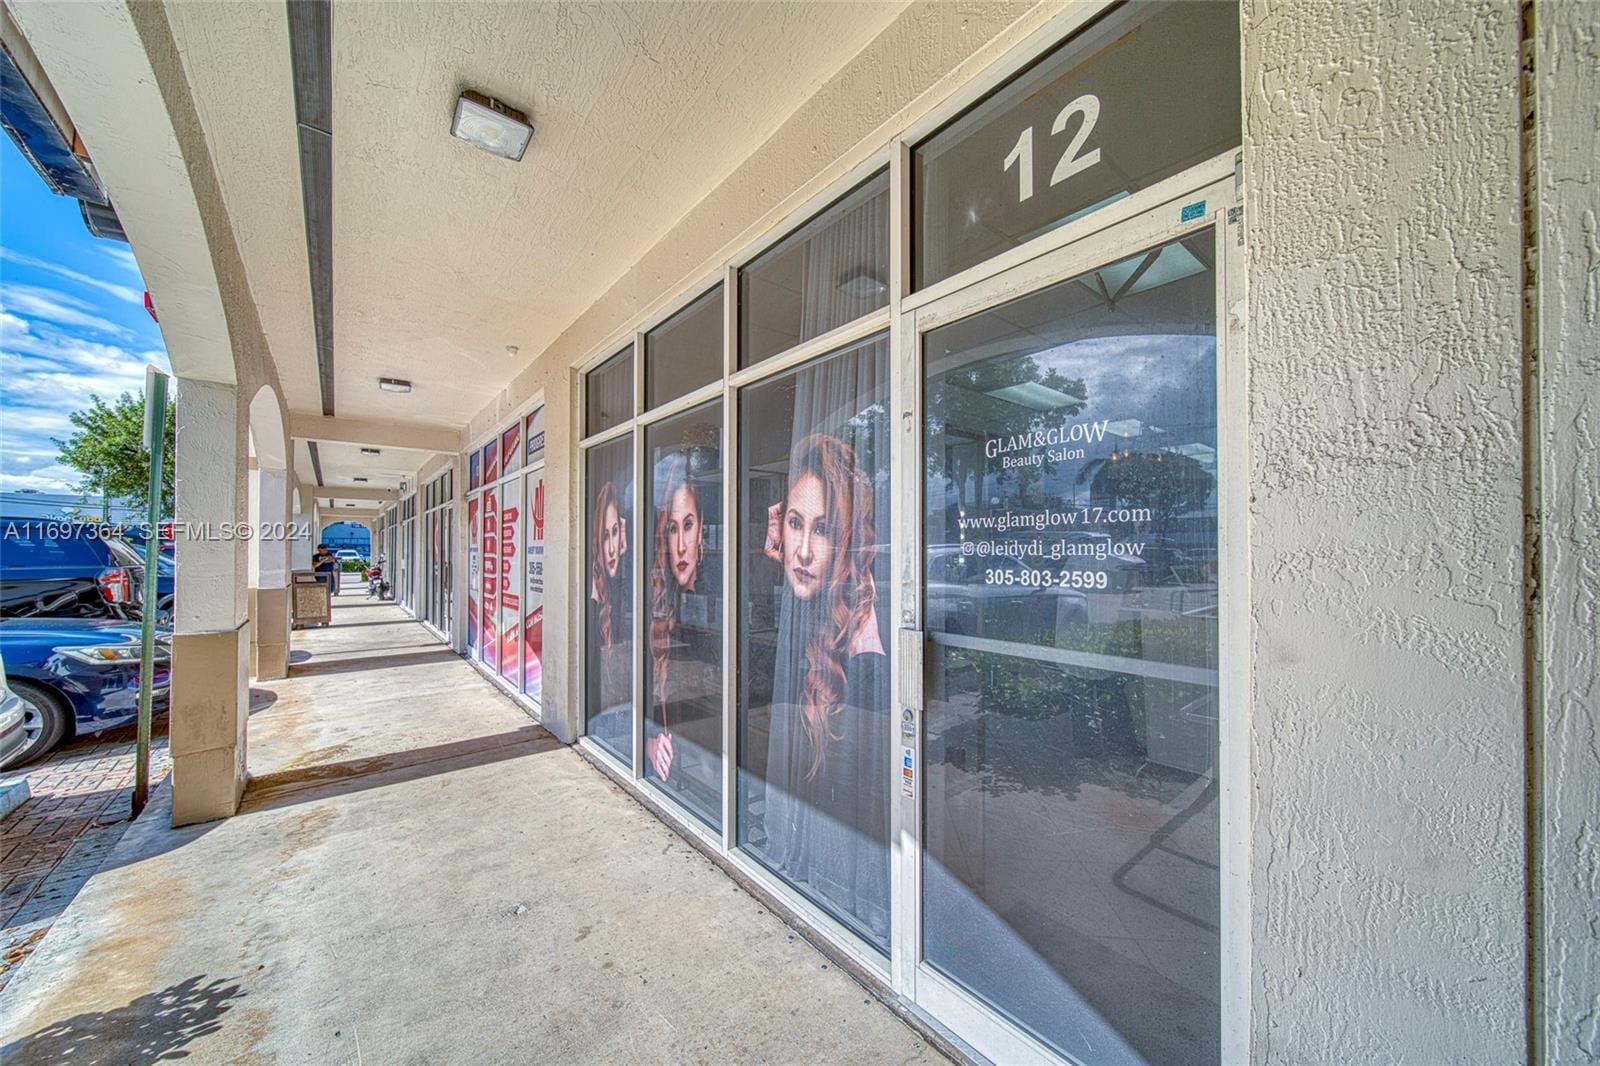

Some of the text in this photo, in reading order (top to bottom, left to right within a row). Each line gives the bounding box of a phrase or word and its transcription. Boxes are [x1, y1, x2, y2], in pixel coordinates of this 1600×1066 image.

[1003, 94, 1101, 203] 12
[985, 420, 1109, 458] GLAM&GLOW
[1002, 447, 1085, 469] Beauty Salon
[976, 538, 1146, 561] @leidydi_glamglow
[985, 569, 1108, 589] 305-803-2599
